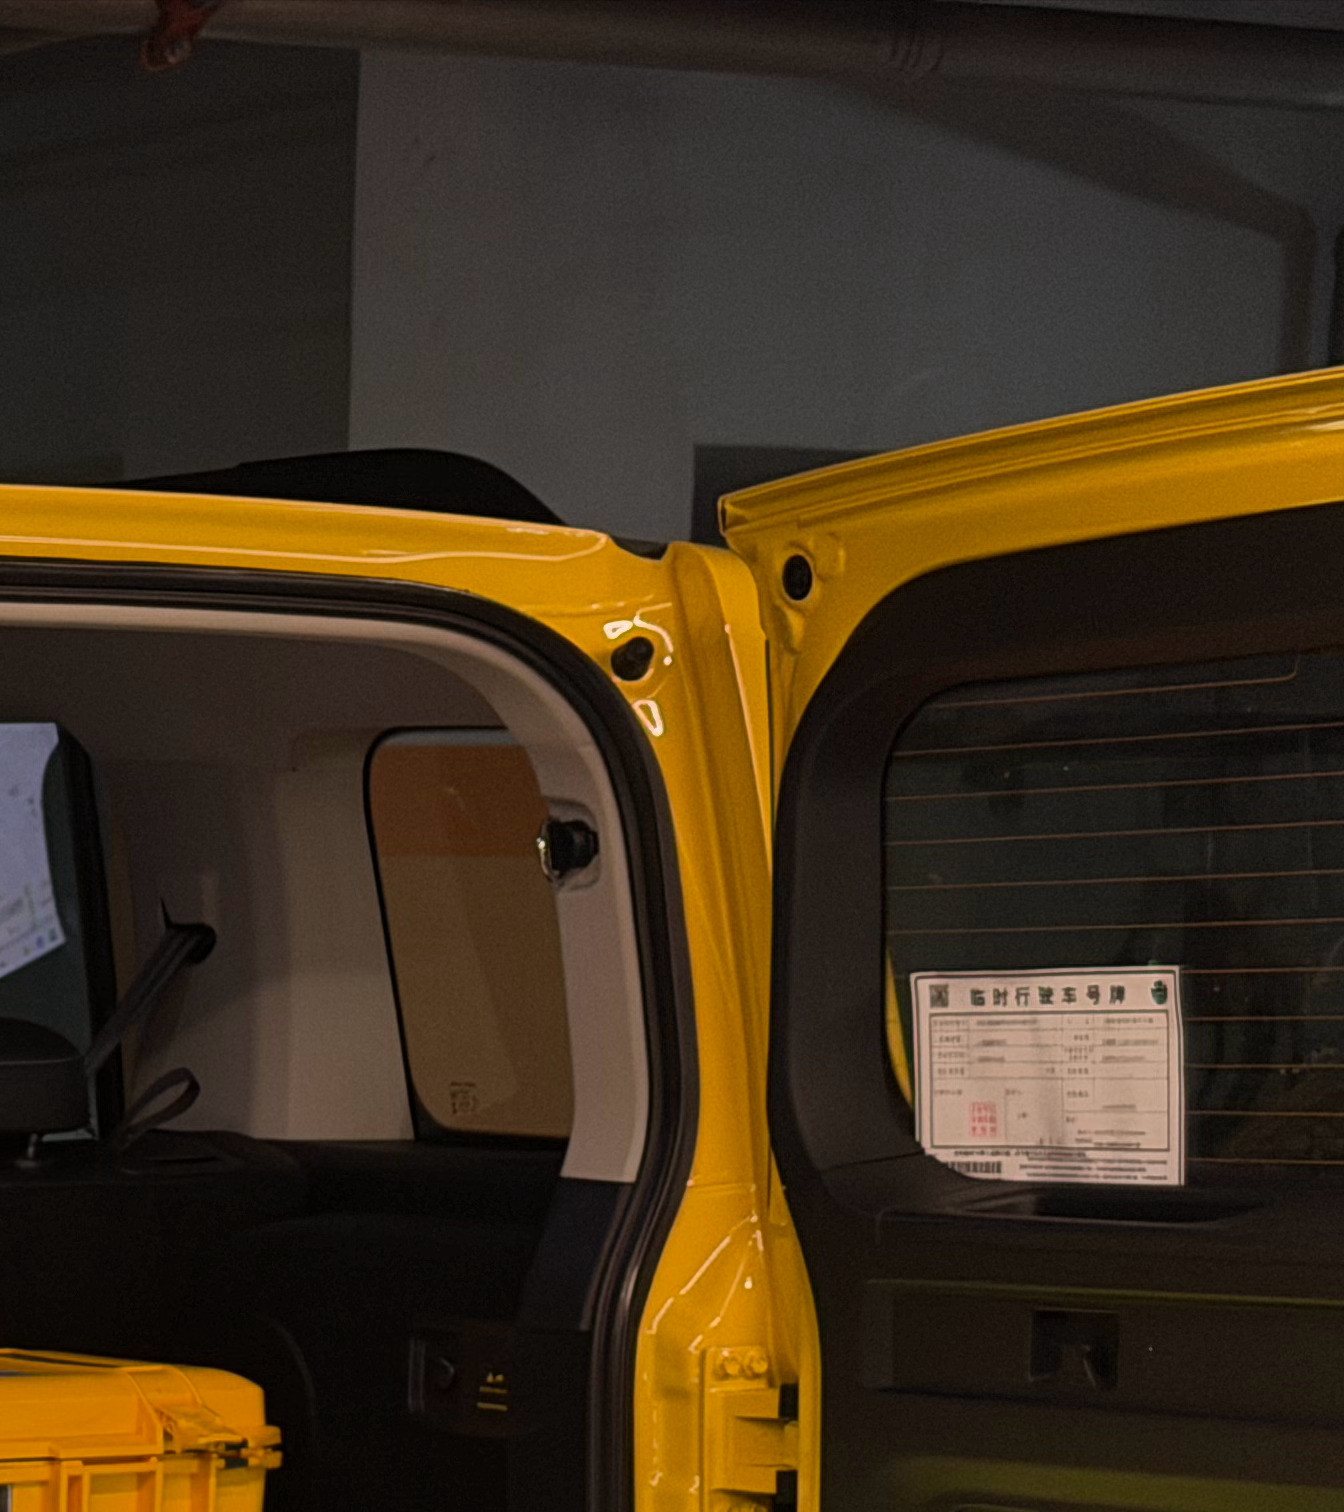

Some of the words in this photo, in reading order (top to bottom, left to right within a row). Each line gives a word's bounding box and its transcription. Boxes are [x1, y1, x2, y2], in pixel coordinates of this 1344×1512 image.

[969, 984, 1126, 1007] 临时行驶车号牌
